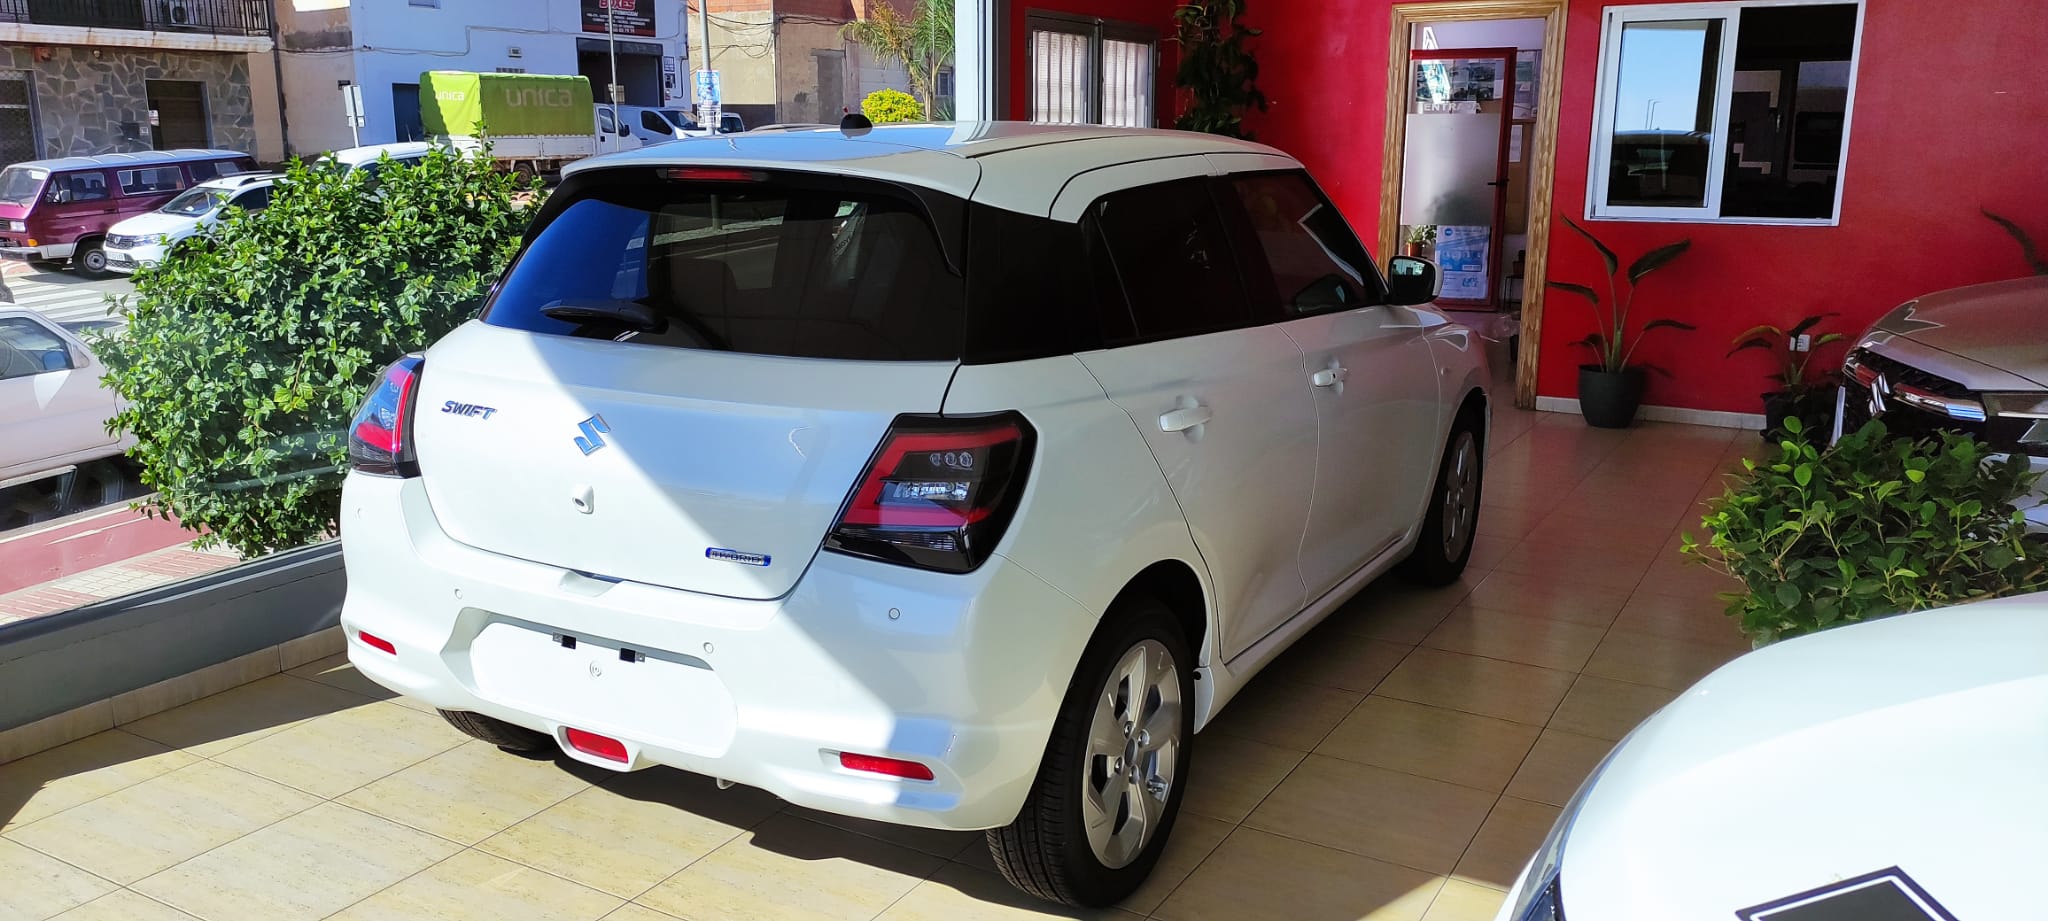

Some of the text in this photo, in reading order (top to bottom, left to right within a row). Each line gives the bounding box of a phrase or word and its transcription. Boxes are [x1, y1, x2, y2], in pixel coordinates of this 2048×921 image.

[505, 88, 573, 108] unica
[1424, 102, 1482, 112] ENTRAA
[441, 400, 498, 420] SWIFT
[710, 550, 764, 563] HYBRID
